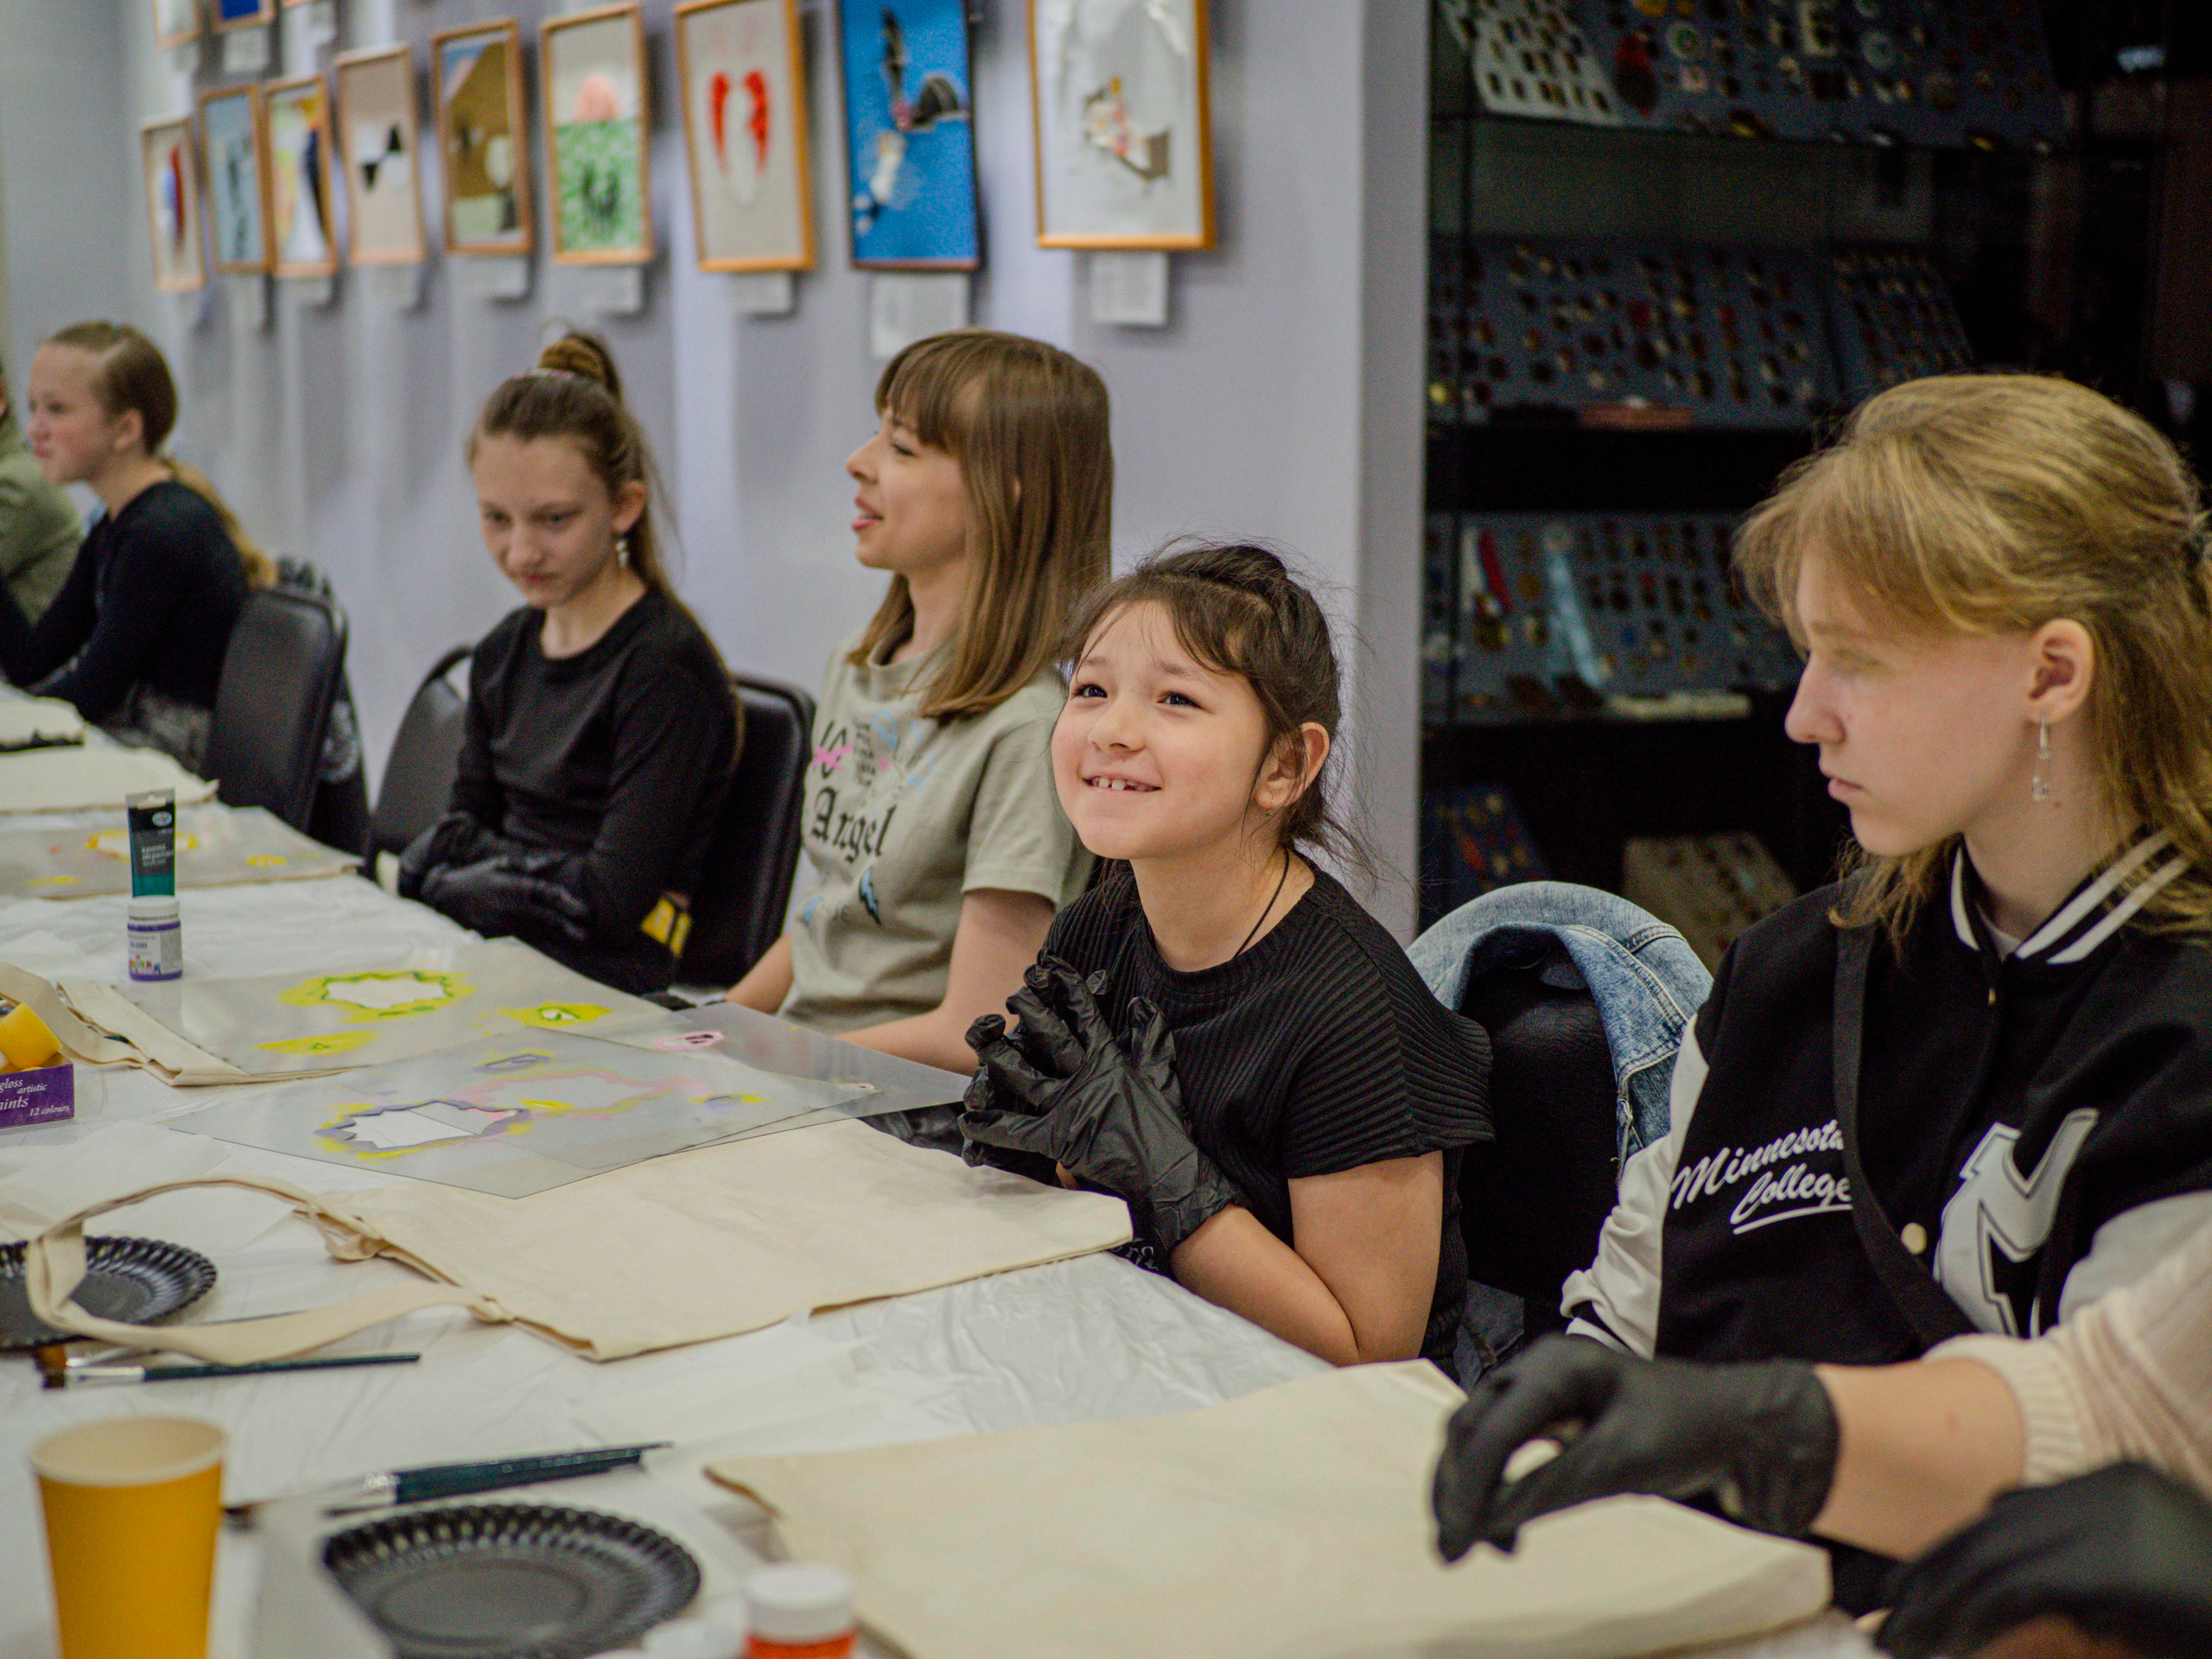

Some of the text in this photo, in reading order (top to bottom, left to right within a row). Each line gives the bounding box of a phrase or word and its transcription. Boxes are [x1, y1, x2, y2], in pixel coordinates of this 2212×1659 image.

[16, 1084, 48, 1094] artistic
[29, 1105, 70, 1116] 12 colours
[1671, 1119, 1844, 1210] Minnesota
[1731, 1162, 1852, 1224] College
